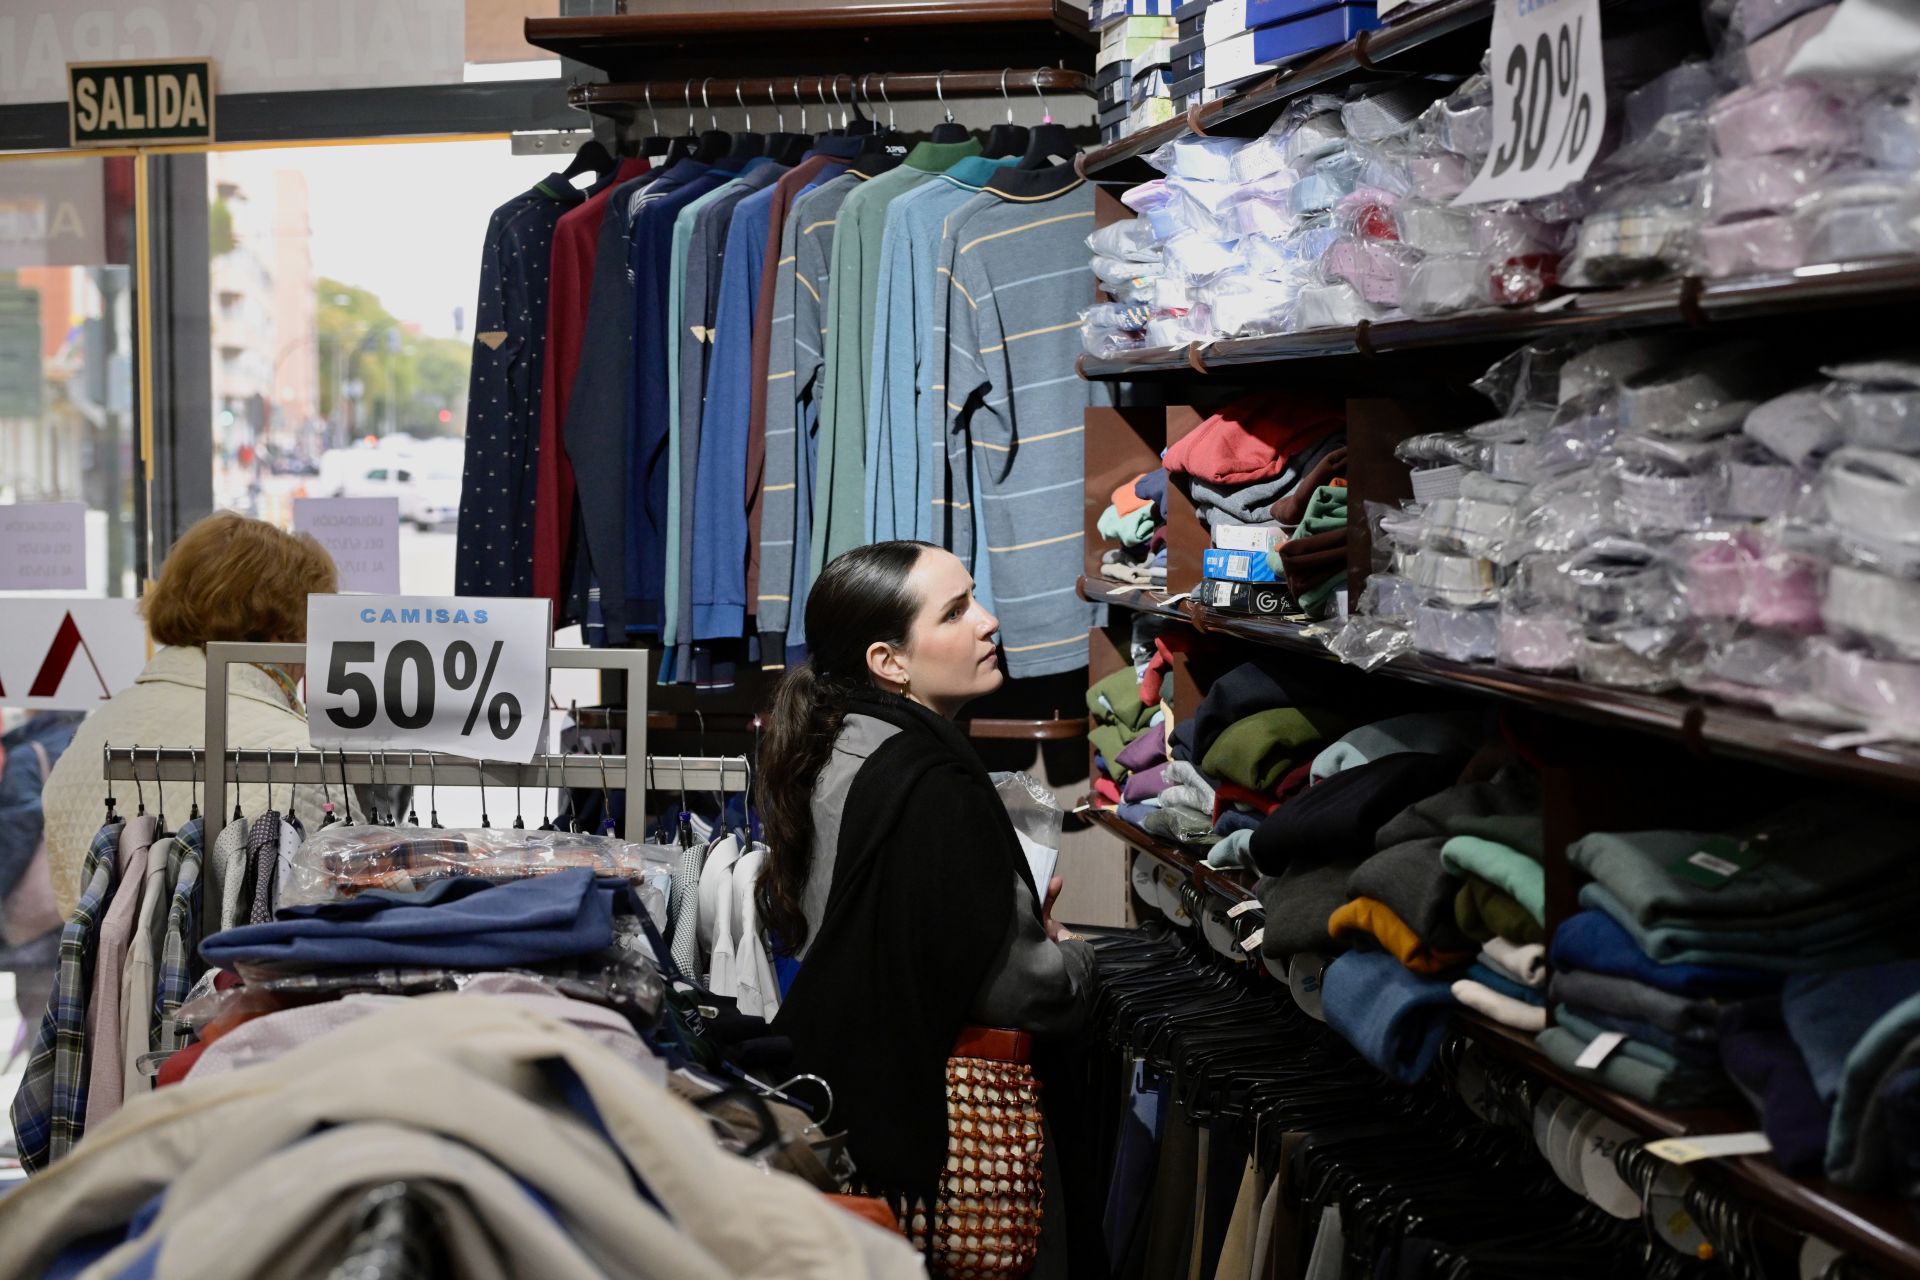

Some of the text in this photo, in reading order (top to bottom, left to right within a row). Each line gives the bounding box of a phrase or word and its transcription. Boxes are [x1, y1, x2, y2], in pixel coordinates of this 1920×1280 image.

[76, 73, 207, 132] SALIDA
[1491, 15, 1591, 178] 30%
[360, 608, 489, 624] CAMISAS
[325, 639, 522, 741] 50%
